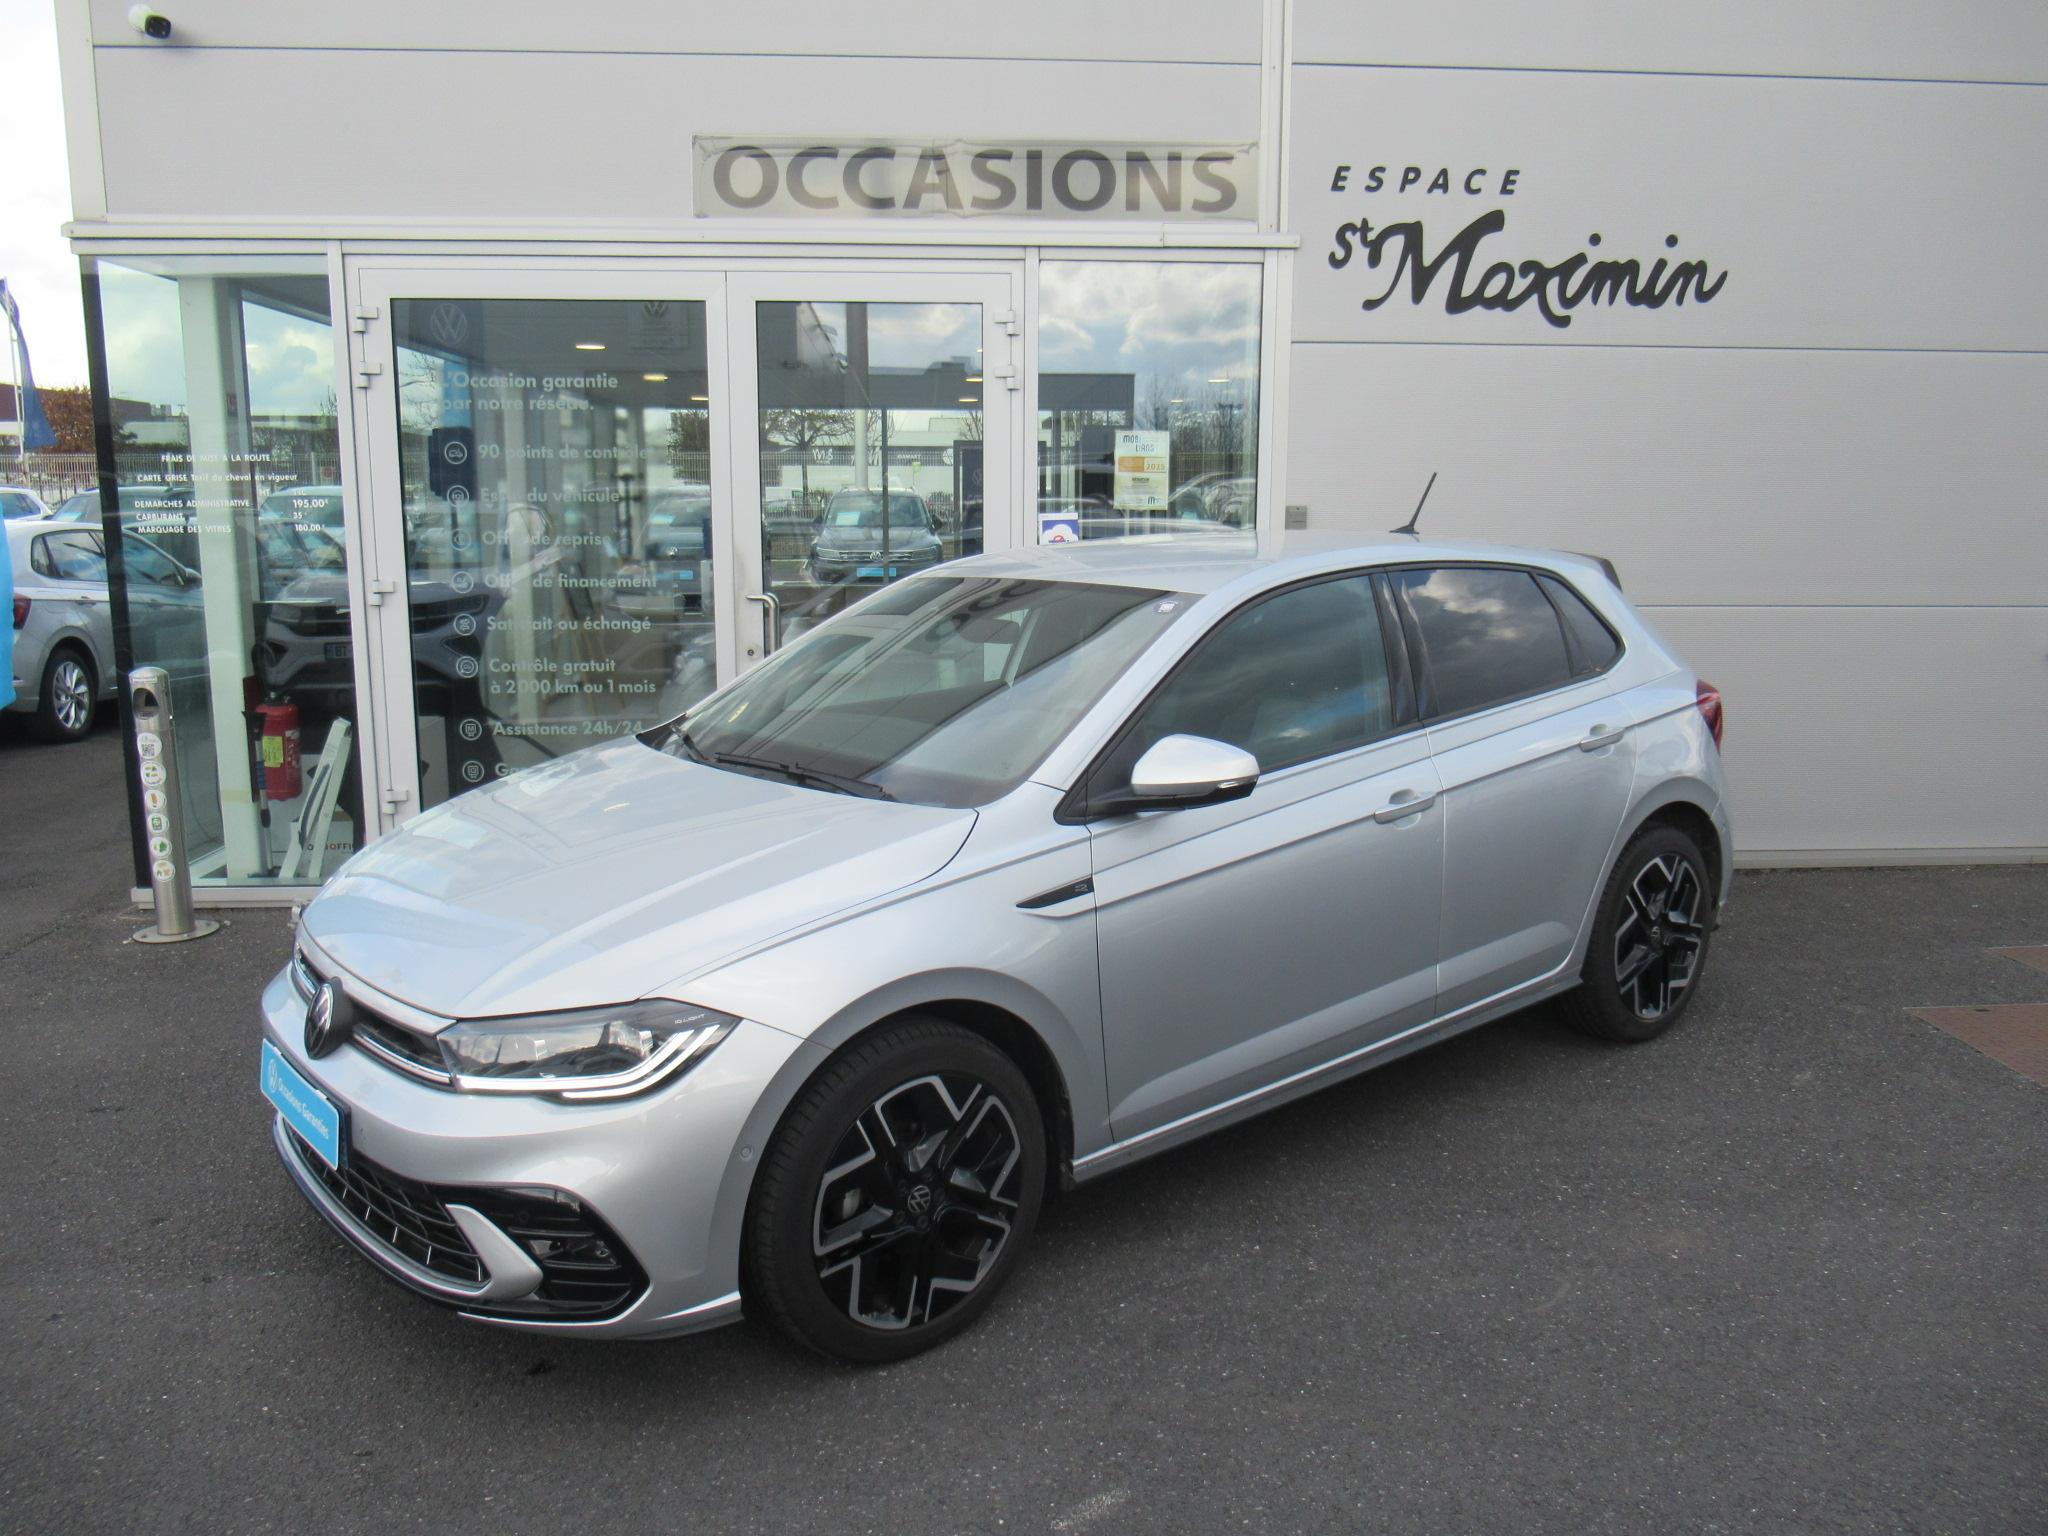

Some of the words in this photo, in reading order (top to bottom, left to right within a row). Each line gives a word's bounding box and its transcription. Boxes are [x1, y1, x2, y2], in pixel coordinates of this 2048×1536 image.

[713, 145, 1238, 213] OCCASIONS
[1330, 165, 1520, 196] ESPACE
[1362, 208, 1729, 329] Maximin
[542, 372, 619, 392] garantie
[161, 454, 183, 463] FRAIS
[231, 453, 242, 462] LA
[244, 453, 271, 462] ROUTE
[478, 443, 501, 459] 90
[559, 442, 580, 459] de
[137, 473, 162, 482] CARTE
[165, 473, 188, 482] GRISE
[225, 472, 252, 481] cheval
[268, 472, 298, 483] vigueur
[527, 487, 548, 502] du
[134, 499, 184, 508] DEMARCHES
[138, 525, 185, 534] MARQUAGE
[187, 525, 202, 533] DES
[482, 529, 528, 546] Off
[530, 530, 551, 545] de
[556, 530, 612, 550] reprise
[484, 573, 530, 589] Off
[532, 572, 553, 588] de
[558, 572, 657, 589] financement
[558, 620, 578, 631] ou
[583, 614, 652, 634] échangé
[489, 657, 557, 672] Contrôle
[563, 658, 616, 676] gratuit
[490, 679, 500, 694] à
[555, 678, 579, 694] km
[583, 683, 603, 694] ou
[618, 680, 656, 694] mois
[492, 721, 577, 736] Assistance
[582, 720, 644, 735] 24h/24
